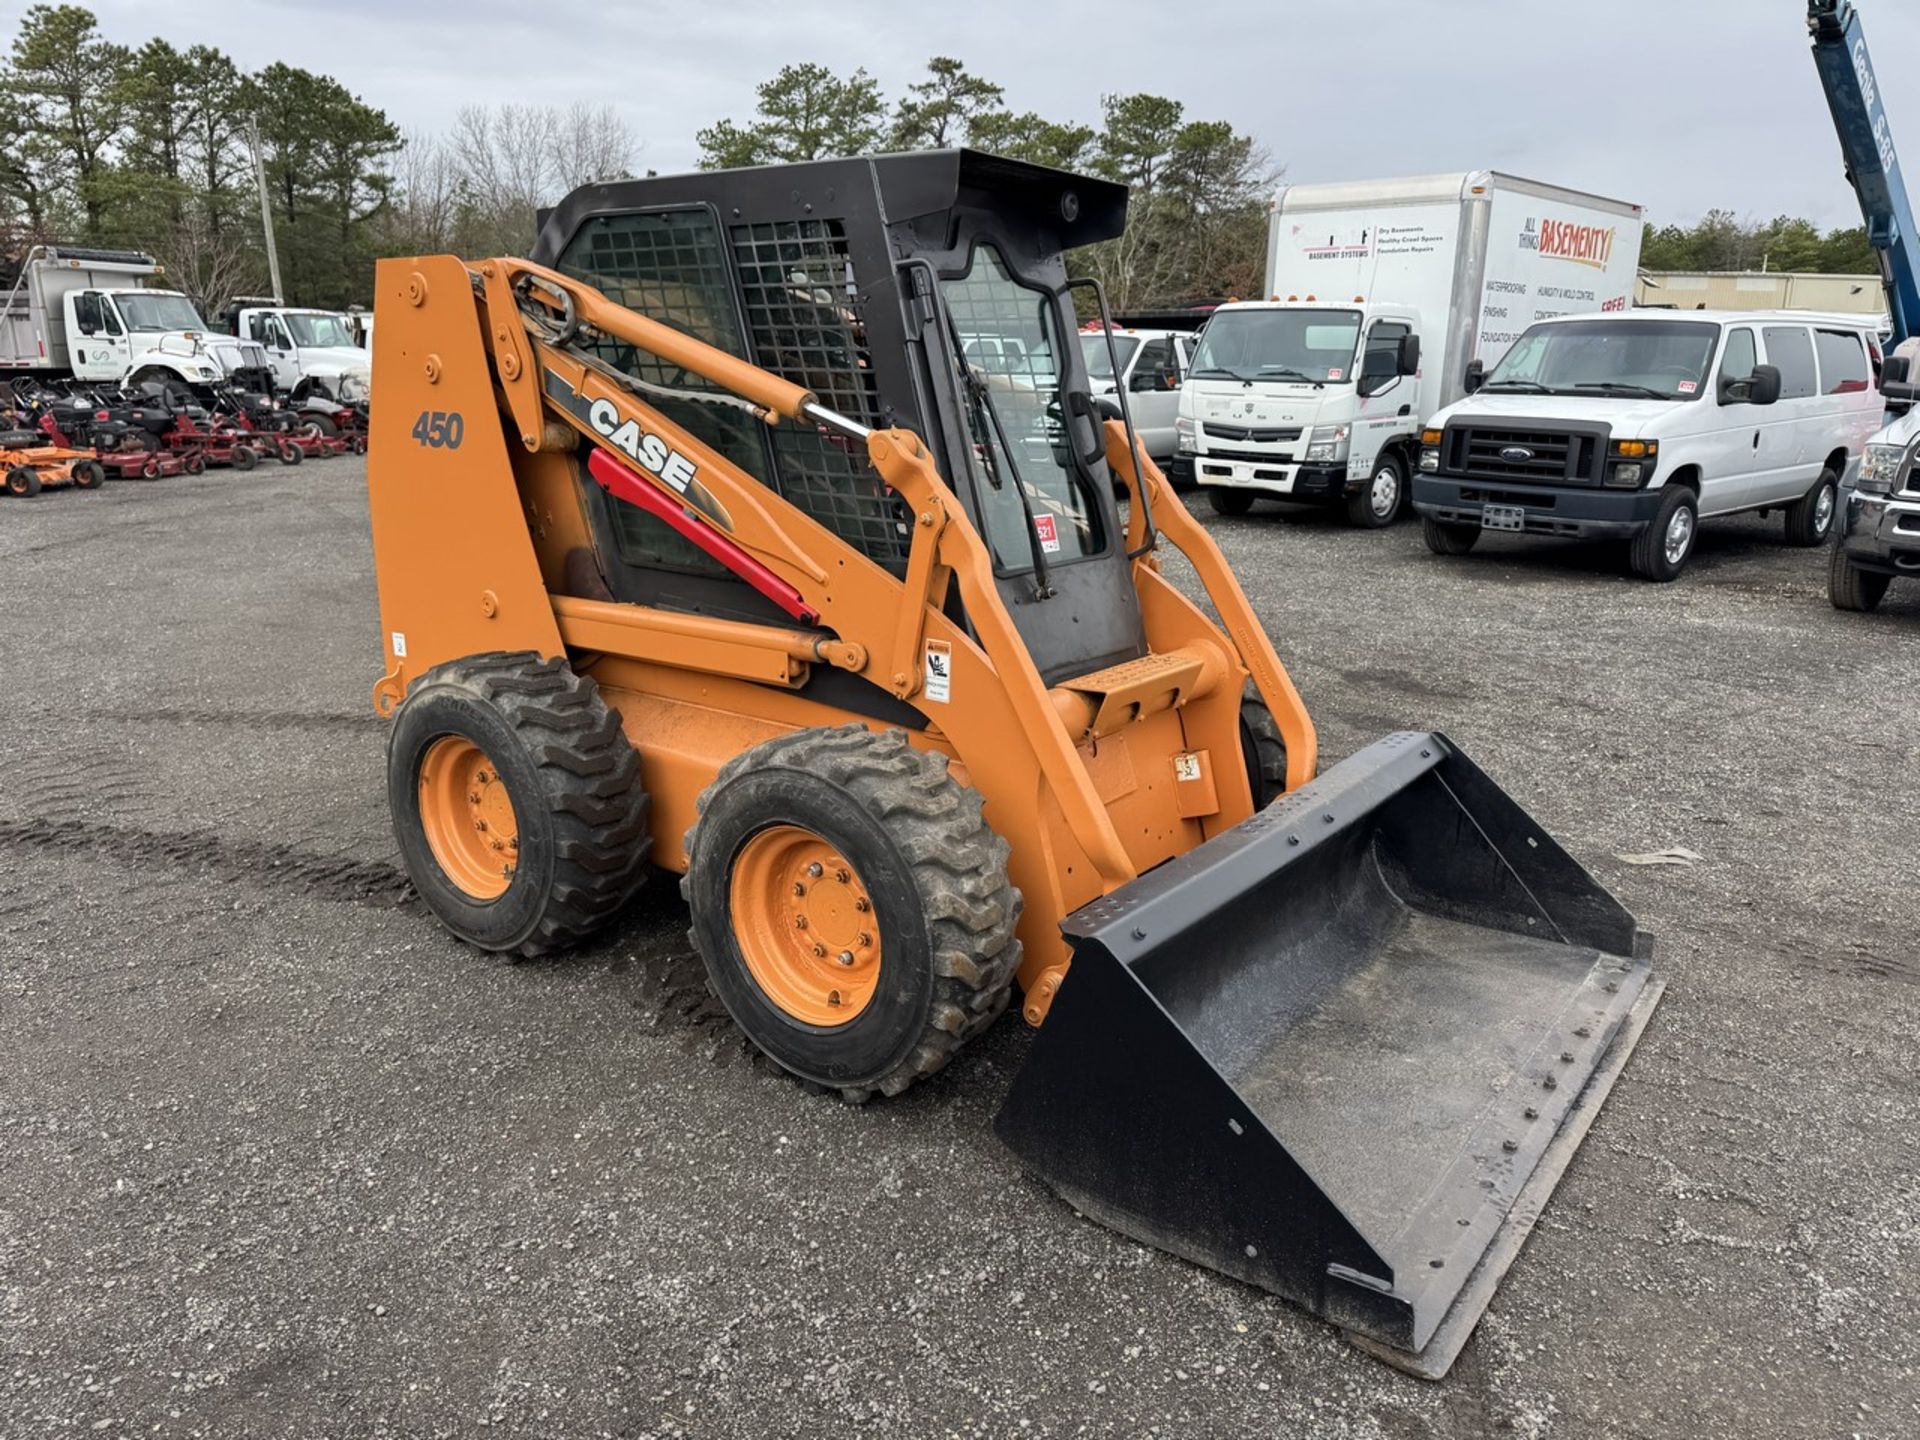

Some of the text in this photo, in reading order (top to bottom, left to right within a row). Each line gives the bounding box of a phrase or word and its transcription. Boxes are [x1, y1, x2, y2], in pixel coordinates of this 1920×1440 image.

[1853, 38, 1875, 112] Genie
[1524, 217, 1536, 233] ALL
[1518, 233, 1539, 250] THINGS
[1308, 250, 1368, 260] BASEMENT SYSTEMS
[1210, 412, 1294, 421] FUSO
[412, 410, 464, 449] 450
[589, 398, 697, 494] CASE
